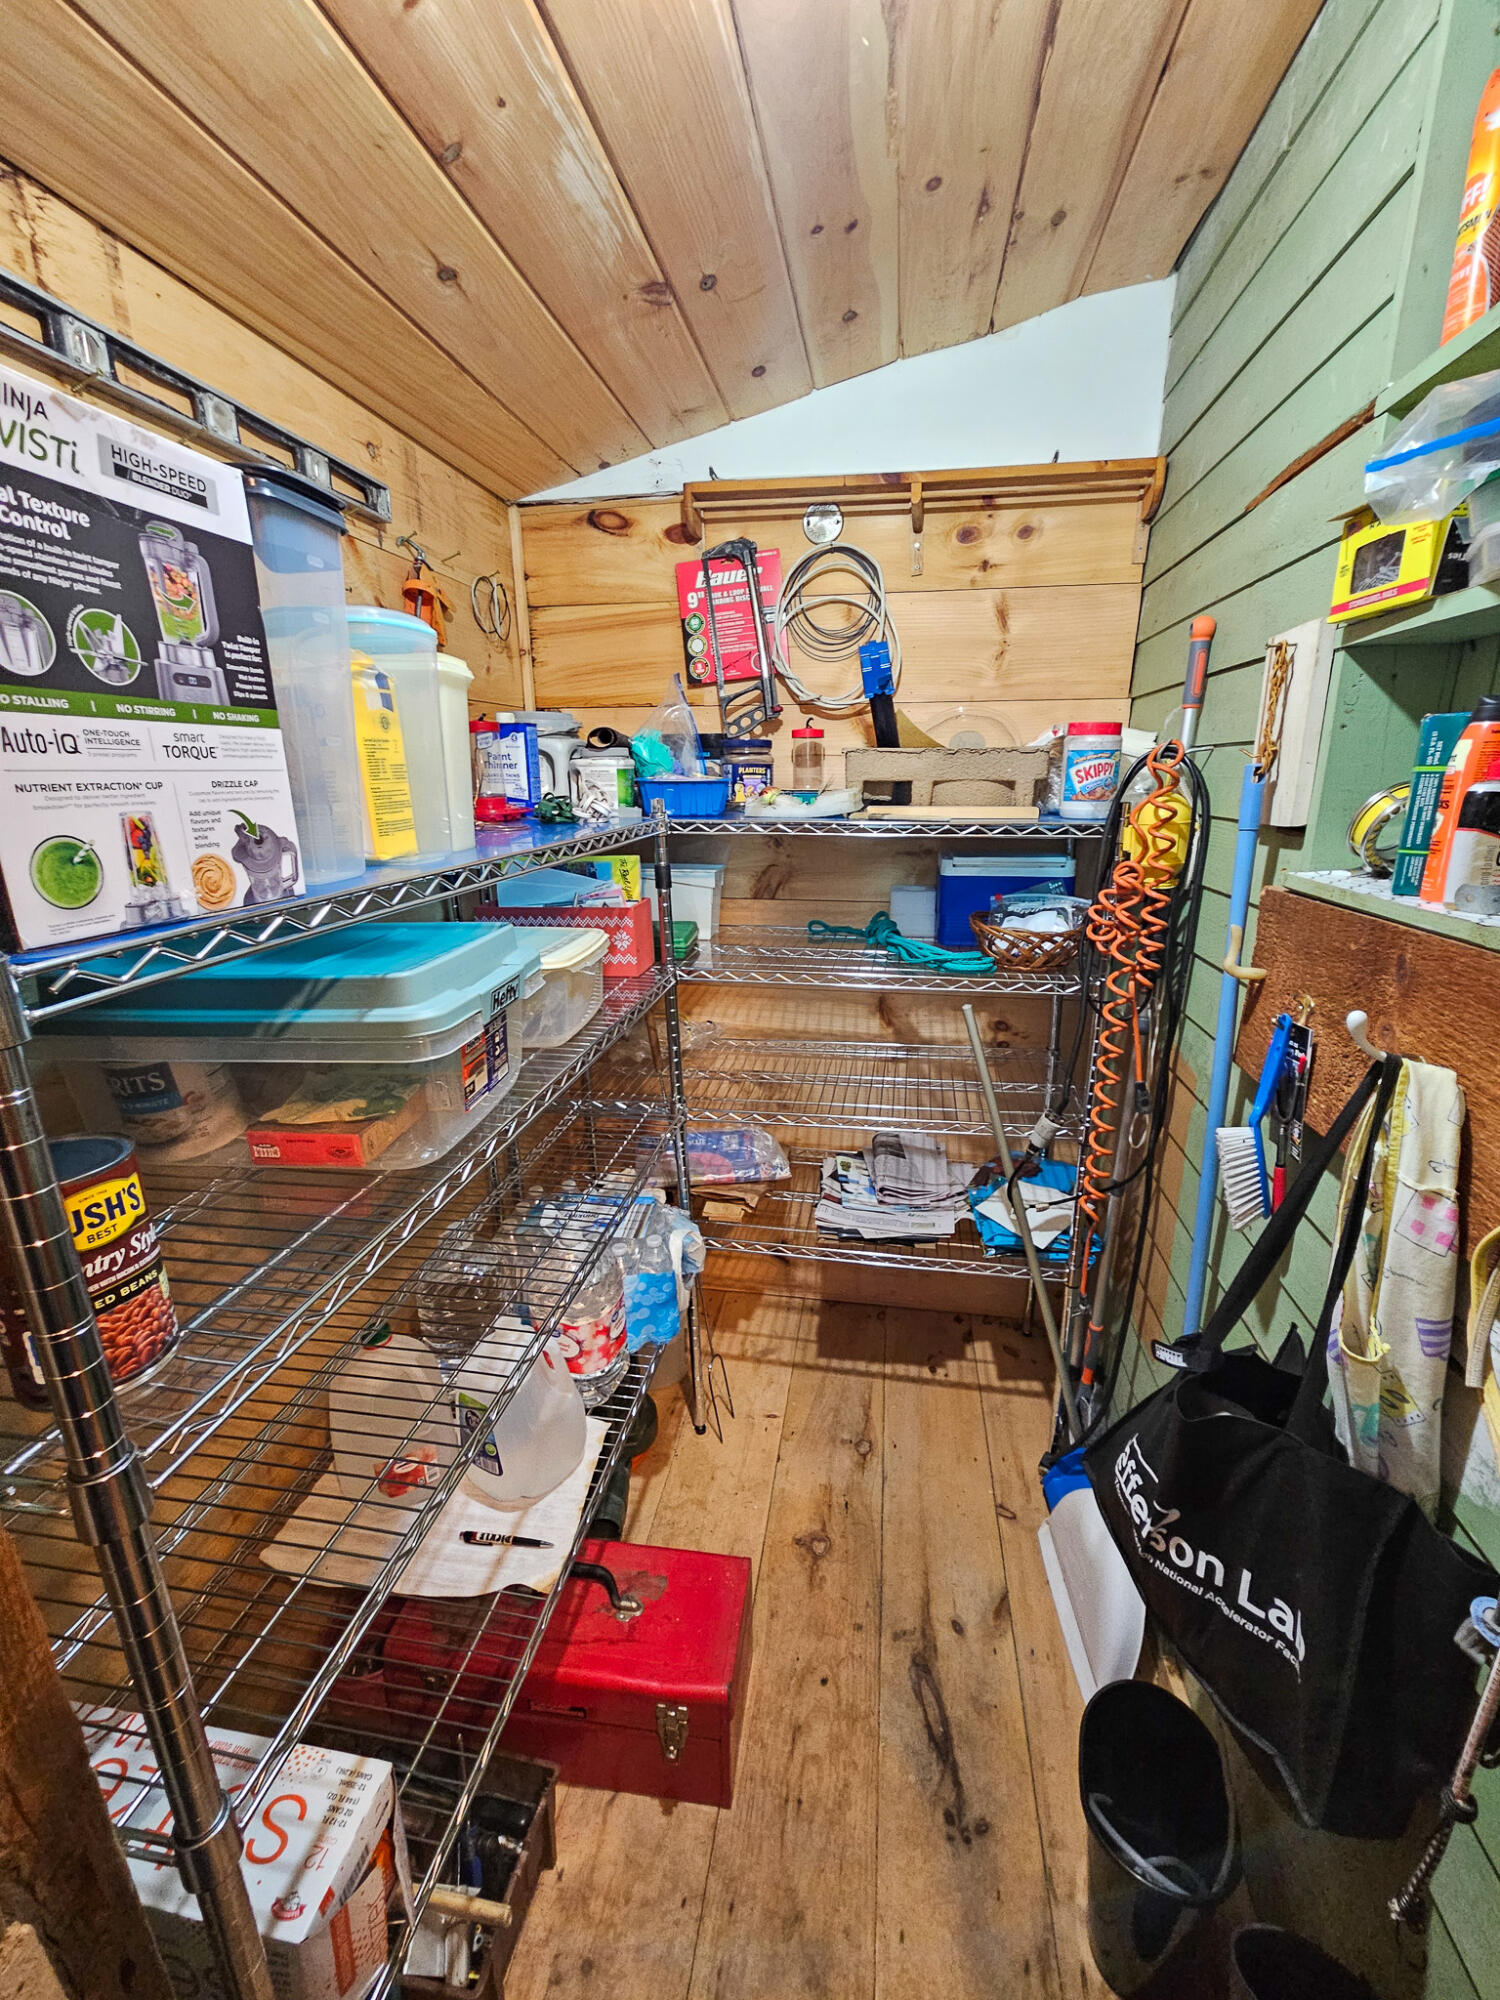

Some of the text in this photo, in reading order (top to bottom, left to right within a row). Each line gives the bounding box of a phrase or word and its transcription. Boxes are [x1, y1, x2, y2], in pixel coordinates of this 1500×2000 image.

[111, 444, 207, 493] HIGH-SPEED
[17, 490, 90, 527] Texture
[0, 504, 72, 540] Control
[12, 694, 69, 709] STALLING
[115, 703, 176, 718] NO STIRRING
[212, 711, 226, 721] NO
[1, 726, 82, 754] Auto-iQ
[83, 728, 130, 738] ONE-TOUCH
[84, 737, 141, 747] INTELLIGENCE
[173, 731, 206, 744] smart
[162, 744, 219, 760] TORQUE
[1075, 761, 1115, 785] SKIPPY
[15, 783, 72, 793] NUTRIENT
[144, 781, 163, 790] CUP
[211, 780, 259, 788] DRIZZLE CAP
[492, 983, 518, 1011] Hefty
[86, 1223, 117, 1244] BEST
[94, 1294, 116, 1310] ED
[120, 1269, 158, 1297] BEANS
[1154, 1559, 1204, 1597] National
[304, 1844, 329, 1871] 12
